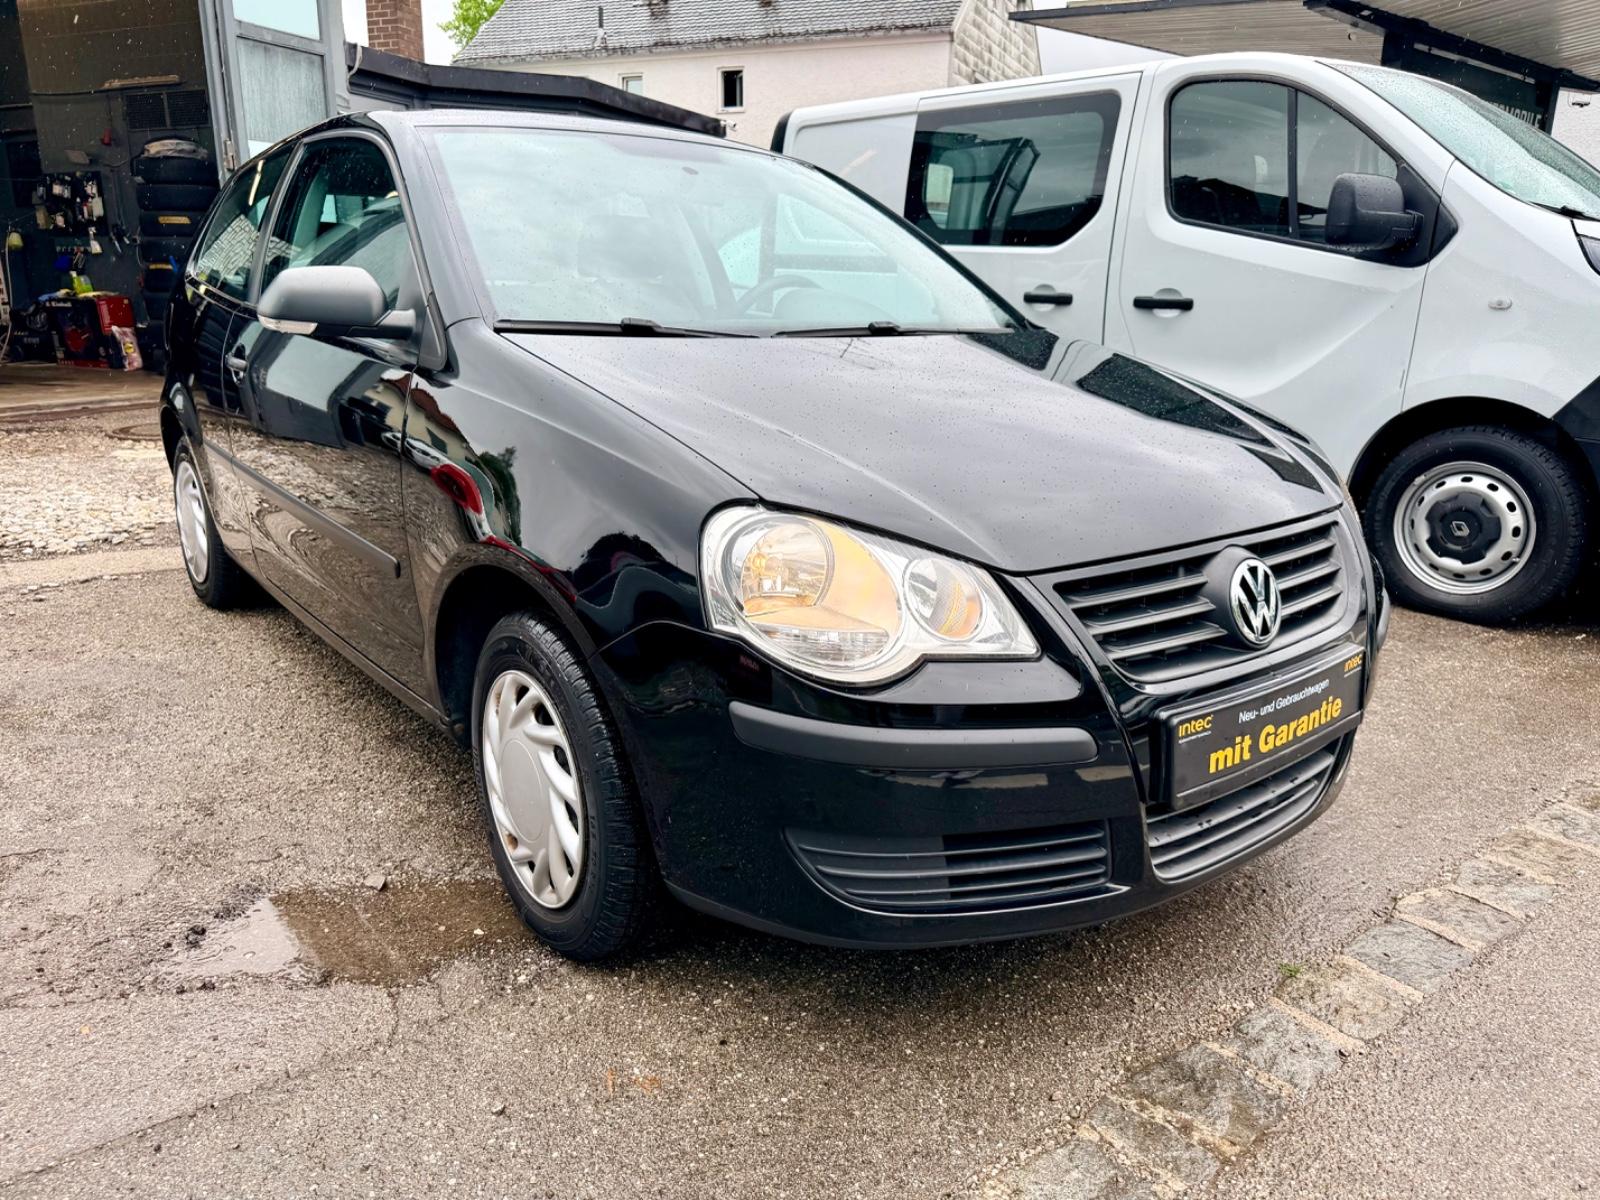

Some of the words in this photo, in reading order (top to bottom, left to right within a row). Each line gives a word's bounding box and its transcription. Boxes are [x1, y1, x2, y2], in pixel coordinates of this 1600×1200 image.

[1230, 558, 1280, 644] VW
[1209, 734, 1253, 774] mit
[1258, 695, 1343, 753] Garantie
[1238, 709, 1259, 723] Neu-
[1260, 700, 1275, 716] und
[1275, 678, 1330, 709] Gebrauchtwagen
